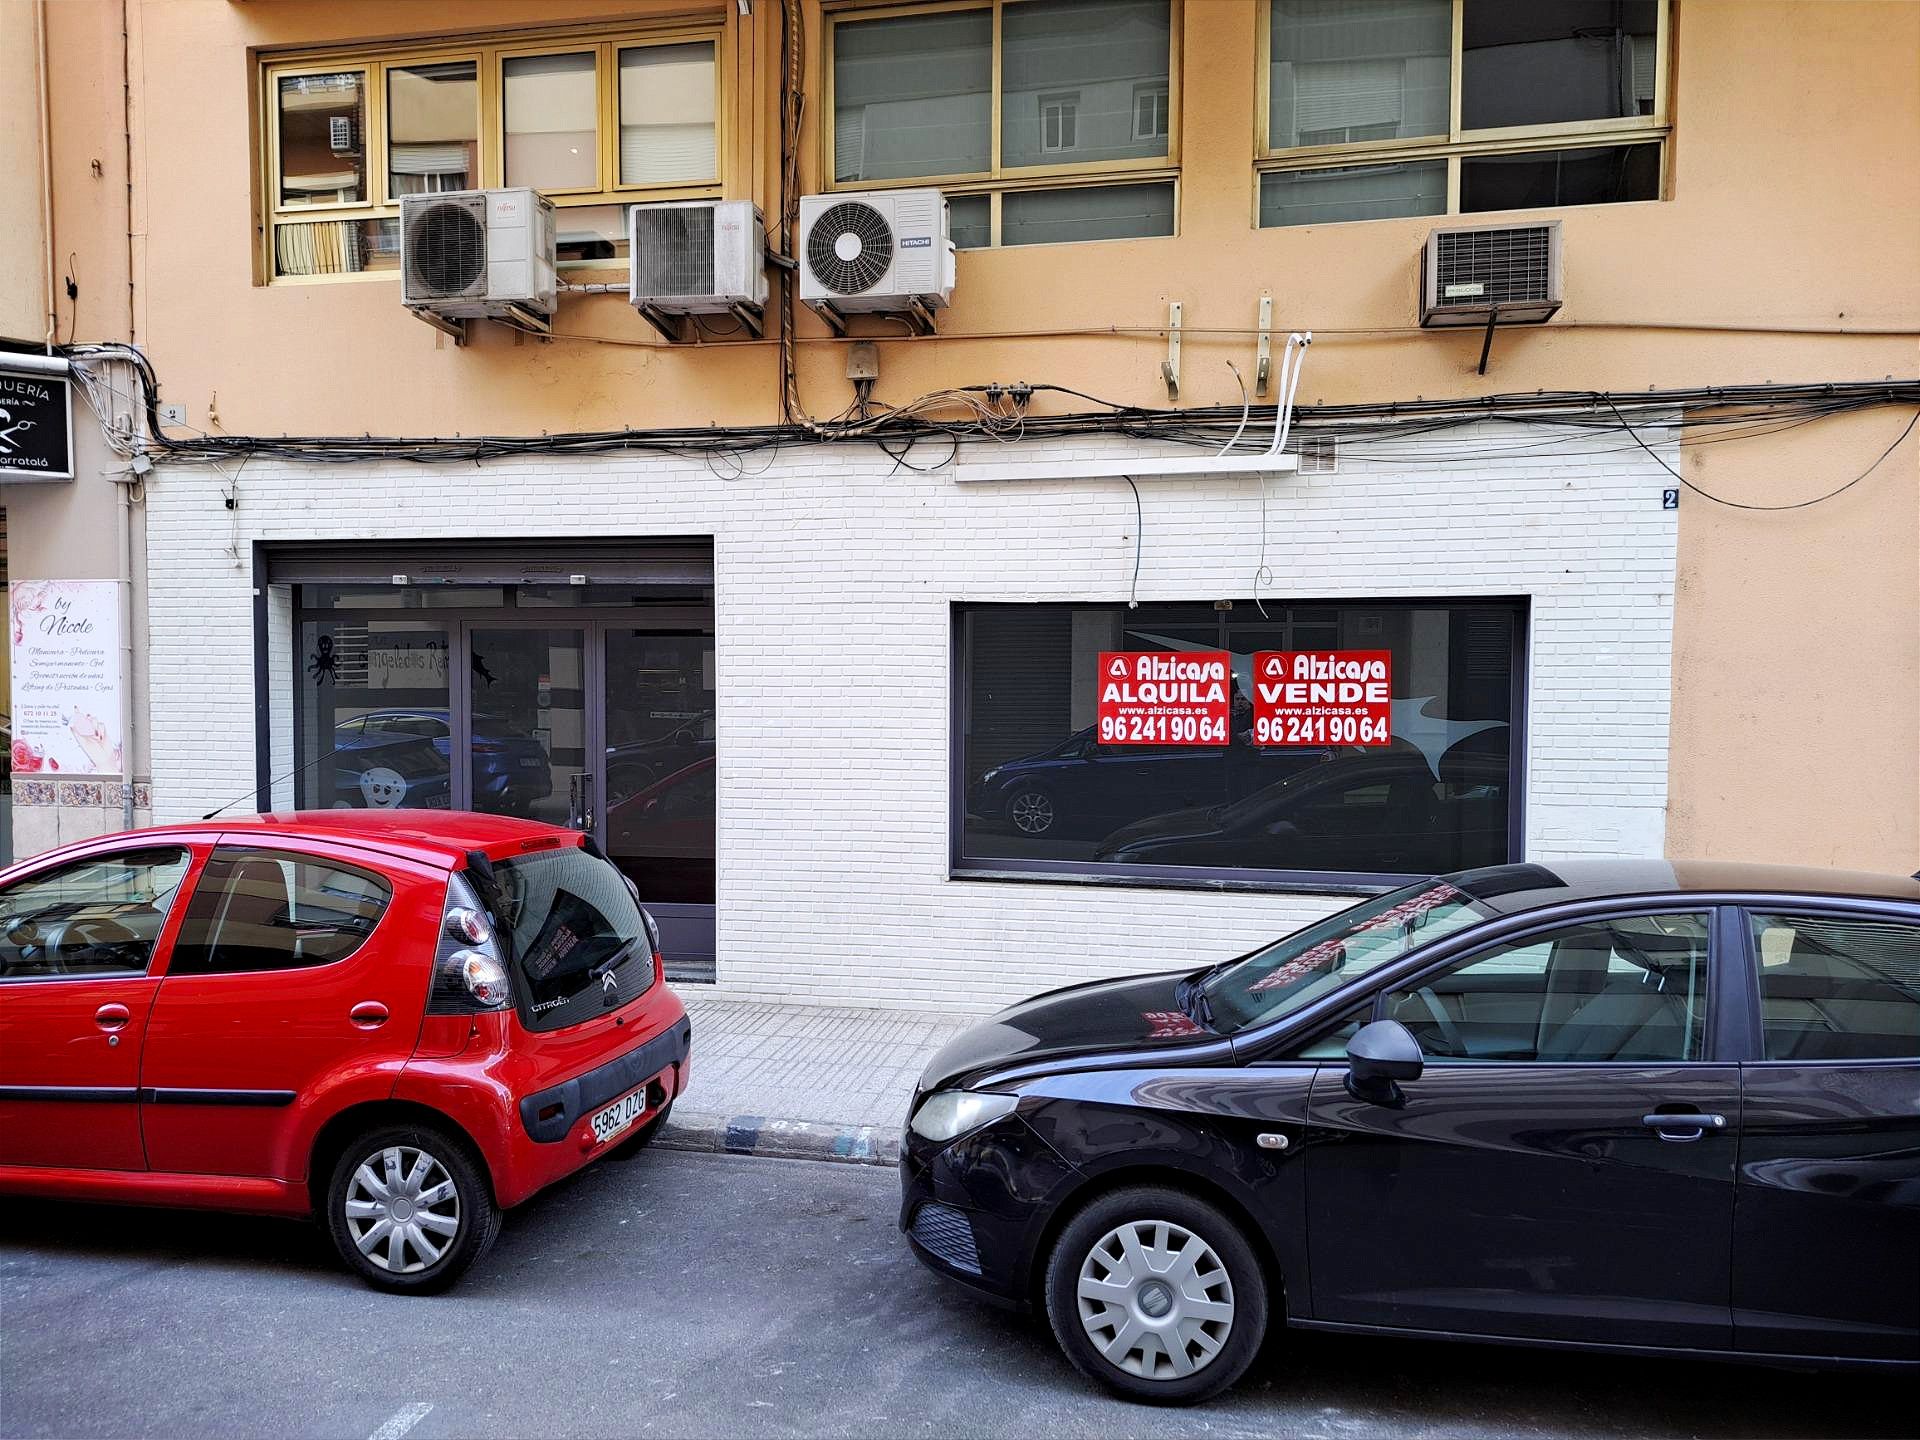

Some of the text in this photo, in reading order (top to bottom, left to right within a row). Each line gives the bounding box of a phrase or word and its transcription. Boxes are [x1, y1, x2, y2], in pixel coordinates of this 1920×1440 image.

[902, 238, 930, 246] HITACHI
[0, 380, 49, 401] UERÍA
[1665, 490, 1676, 508] 2
[54, 597, 72, 614] by
[40, 614, 94, 636] Nicole
[1136, 655, 1225, 682] Alzicasa
[1293, 654, 1385, 682] Alzicasa
[1102, 683, 1226, 704] ALQUILA
[1257, 683, 1388, 704] VENDE
[1119, 706, 1208, 716] www.alzicasa.es
[1275, 706, 1368, 716] www.alzicasa.es
[594, 1089, 645, 1138] 5962 DZG
